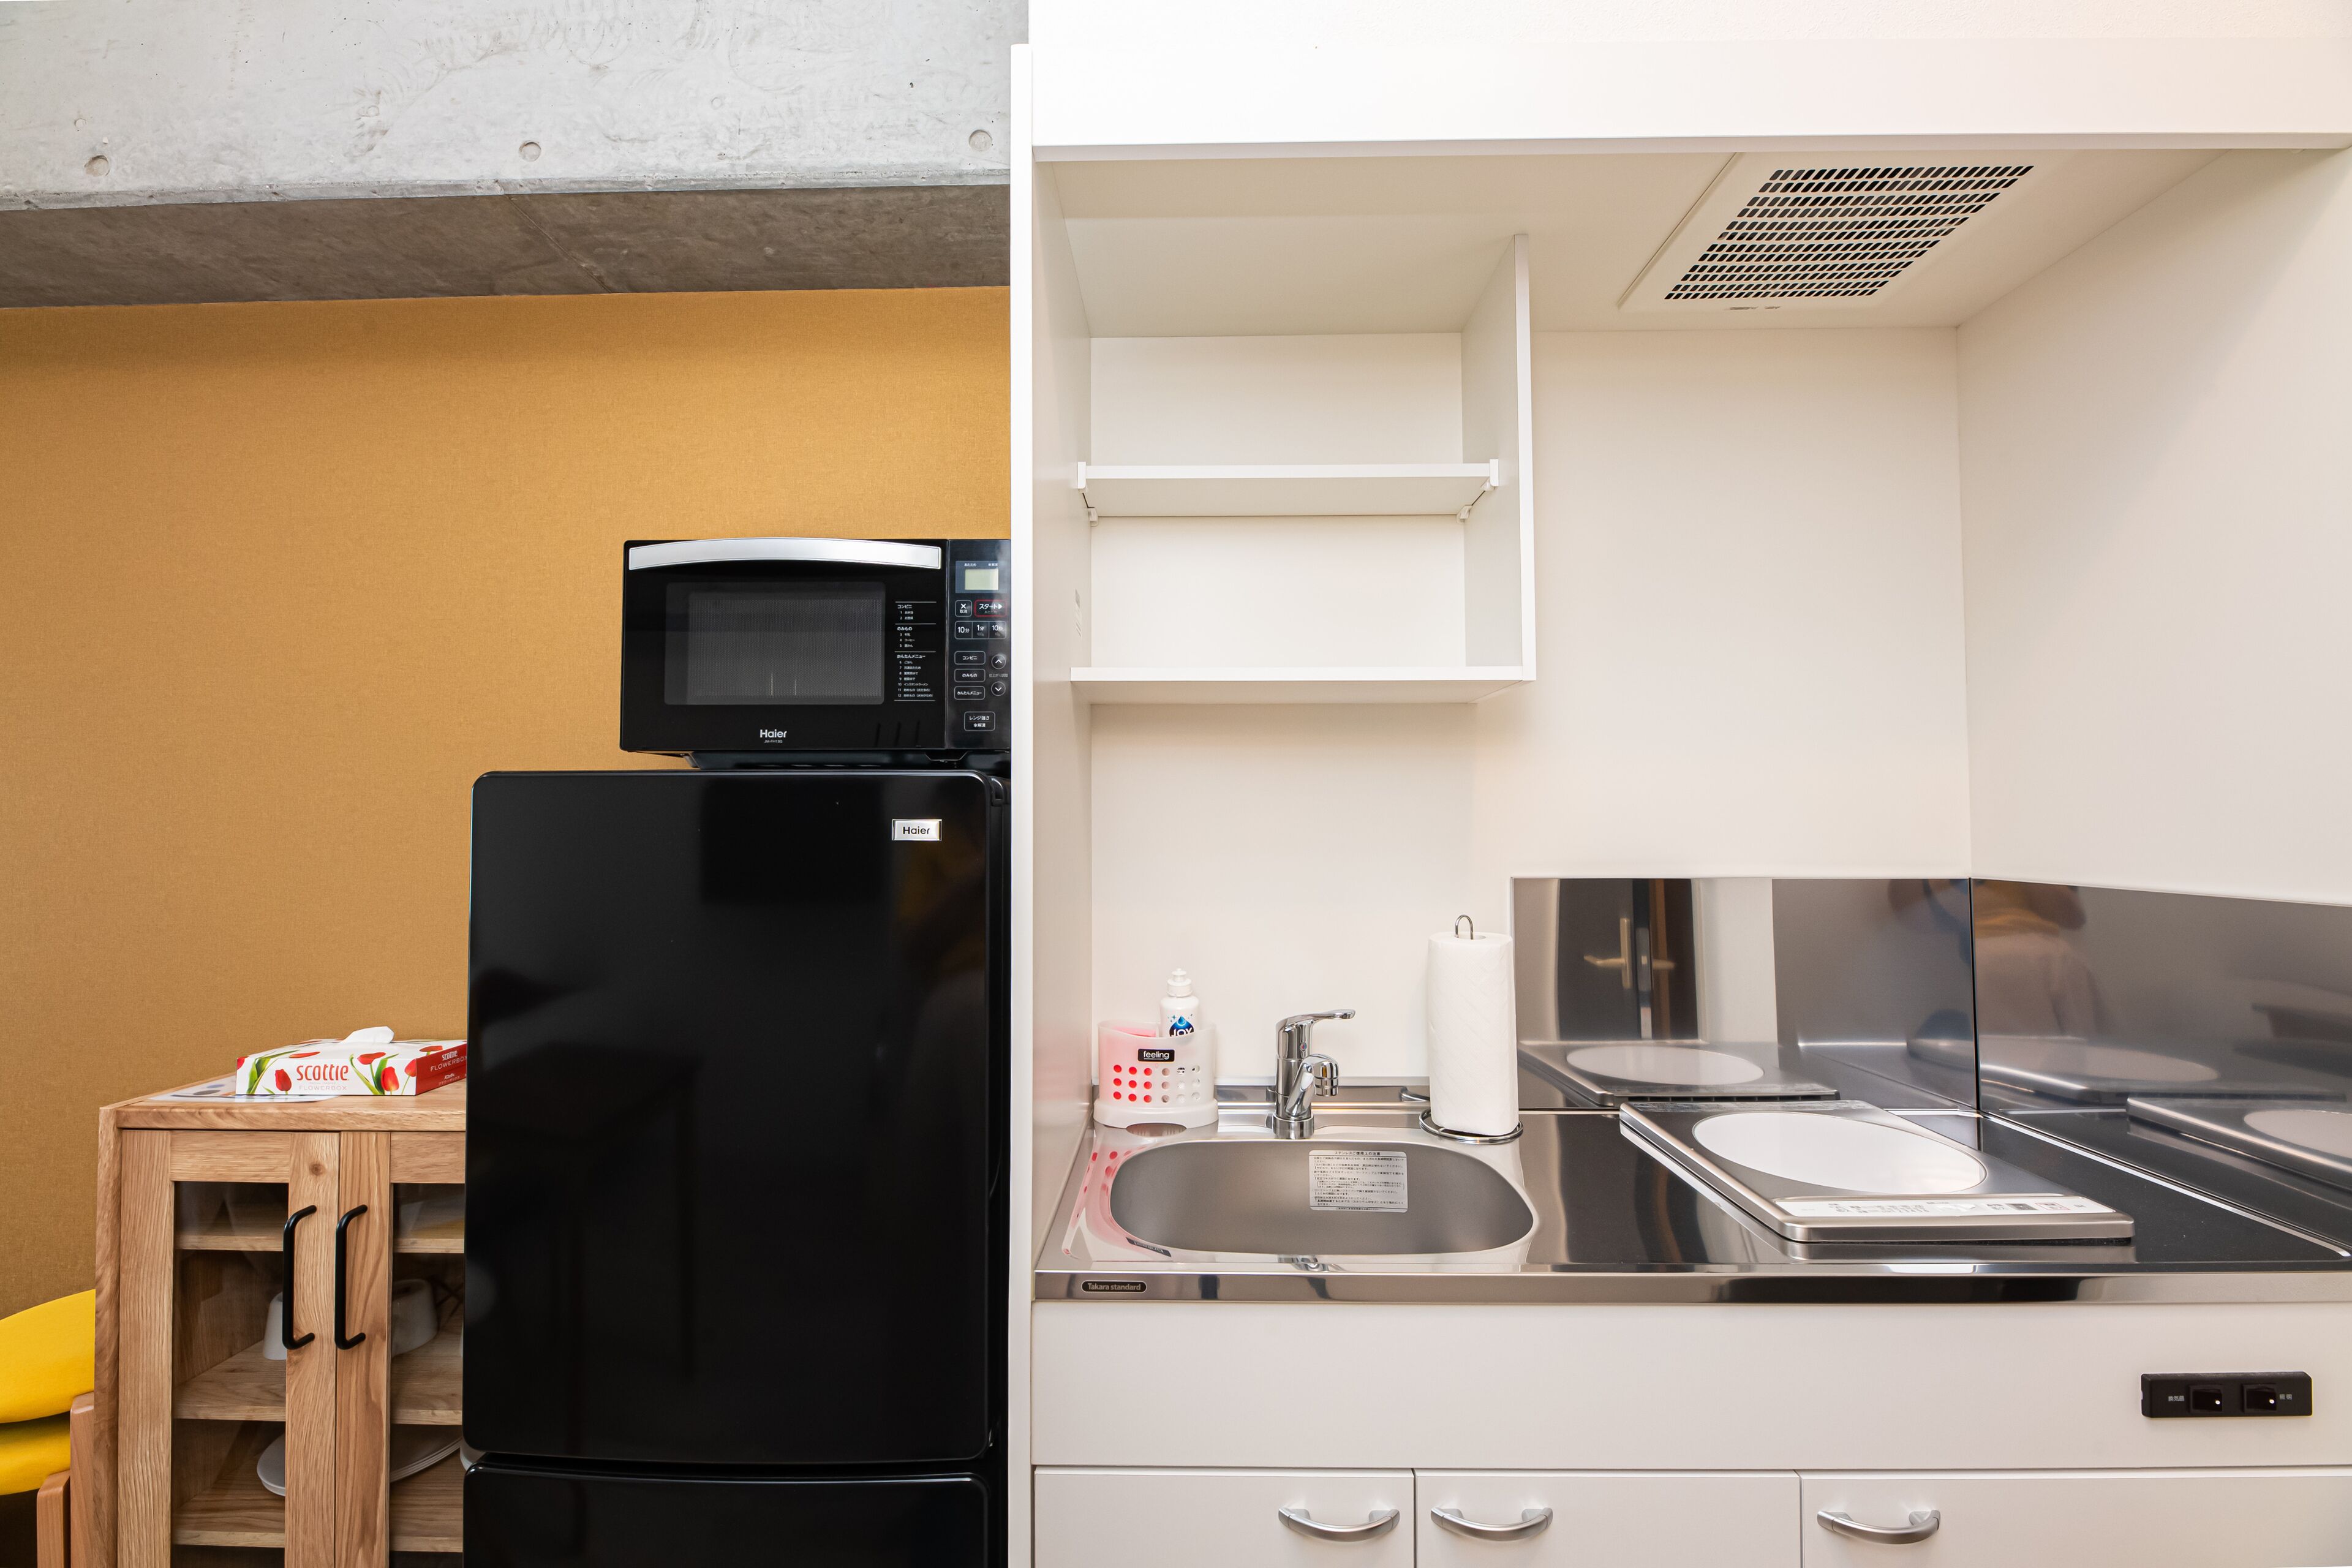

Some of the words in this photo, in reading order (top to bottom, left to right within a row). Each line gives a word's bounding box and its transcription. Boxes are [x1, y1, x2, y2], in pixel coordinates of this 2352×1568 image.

[760, 729, 787, 738] Haier
[903, 826, 930, 834] Haier
[1144, 1050, 1170, 1060] feeling
[296, 1064, 349, 1080] scottie
